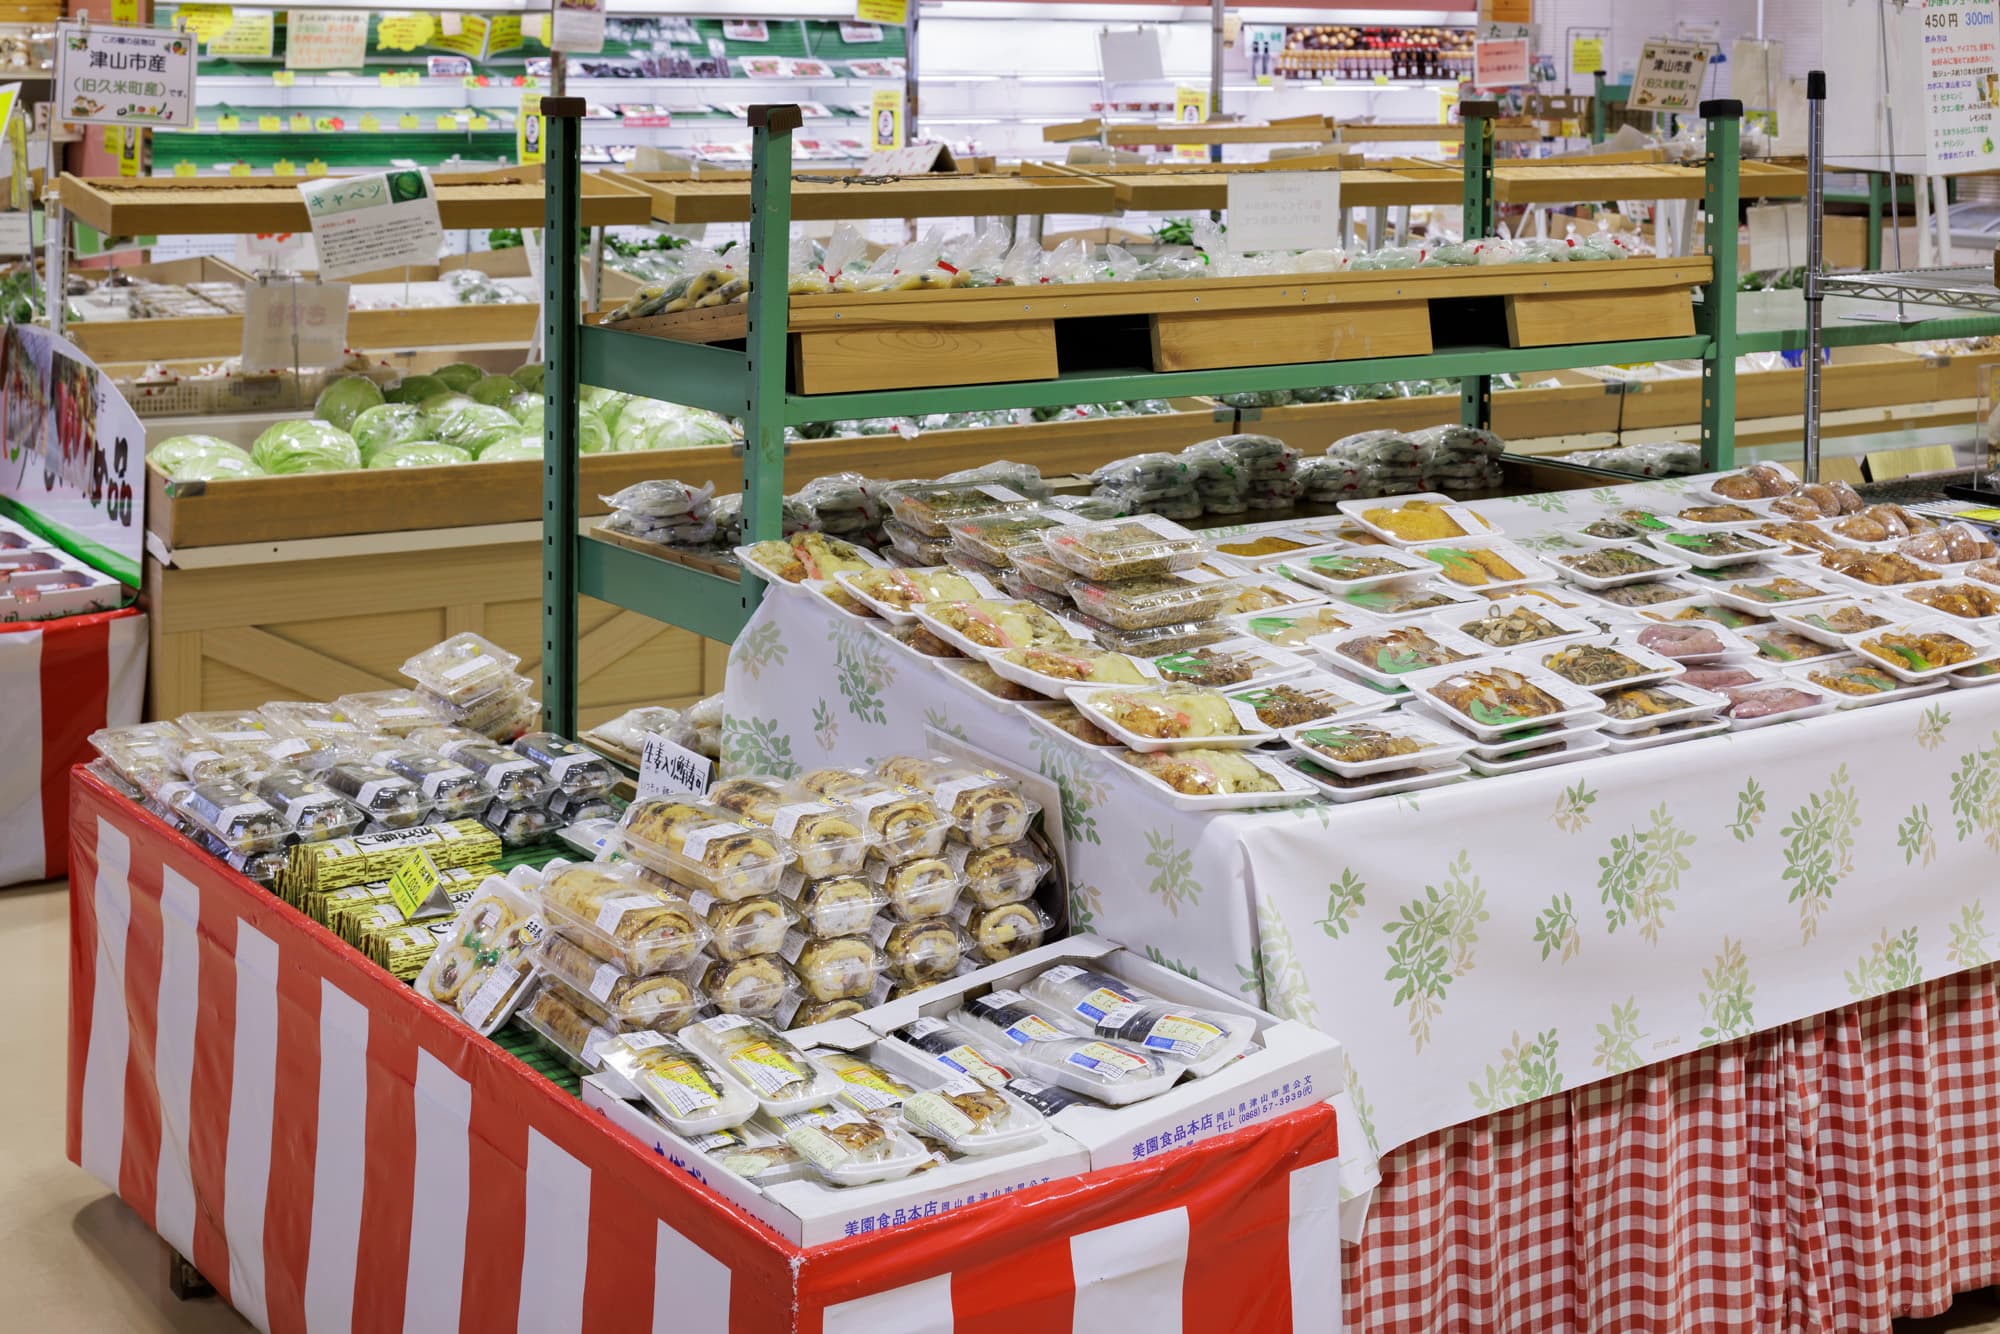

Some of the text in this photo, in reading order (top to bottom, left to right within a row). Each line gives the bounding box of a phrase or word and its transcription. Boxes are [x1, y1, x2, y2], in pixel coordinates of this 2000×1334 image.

[1965, 11, 1994, 25] 300ml
[90, 51, 167, 73] 津山市産
[311, 184, 381, 209] キャベツ
[1133, 1113, 1214, 1160] 美園食品本店
[1217, 1123, 1234, 1133] TEL
[845, 1200, 938, 1237] 美園食品本店
